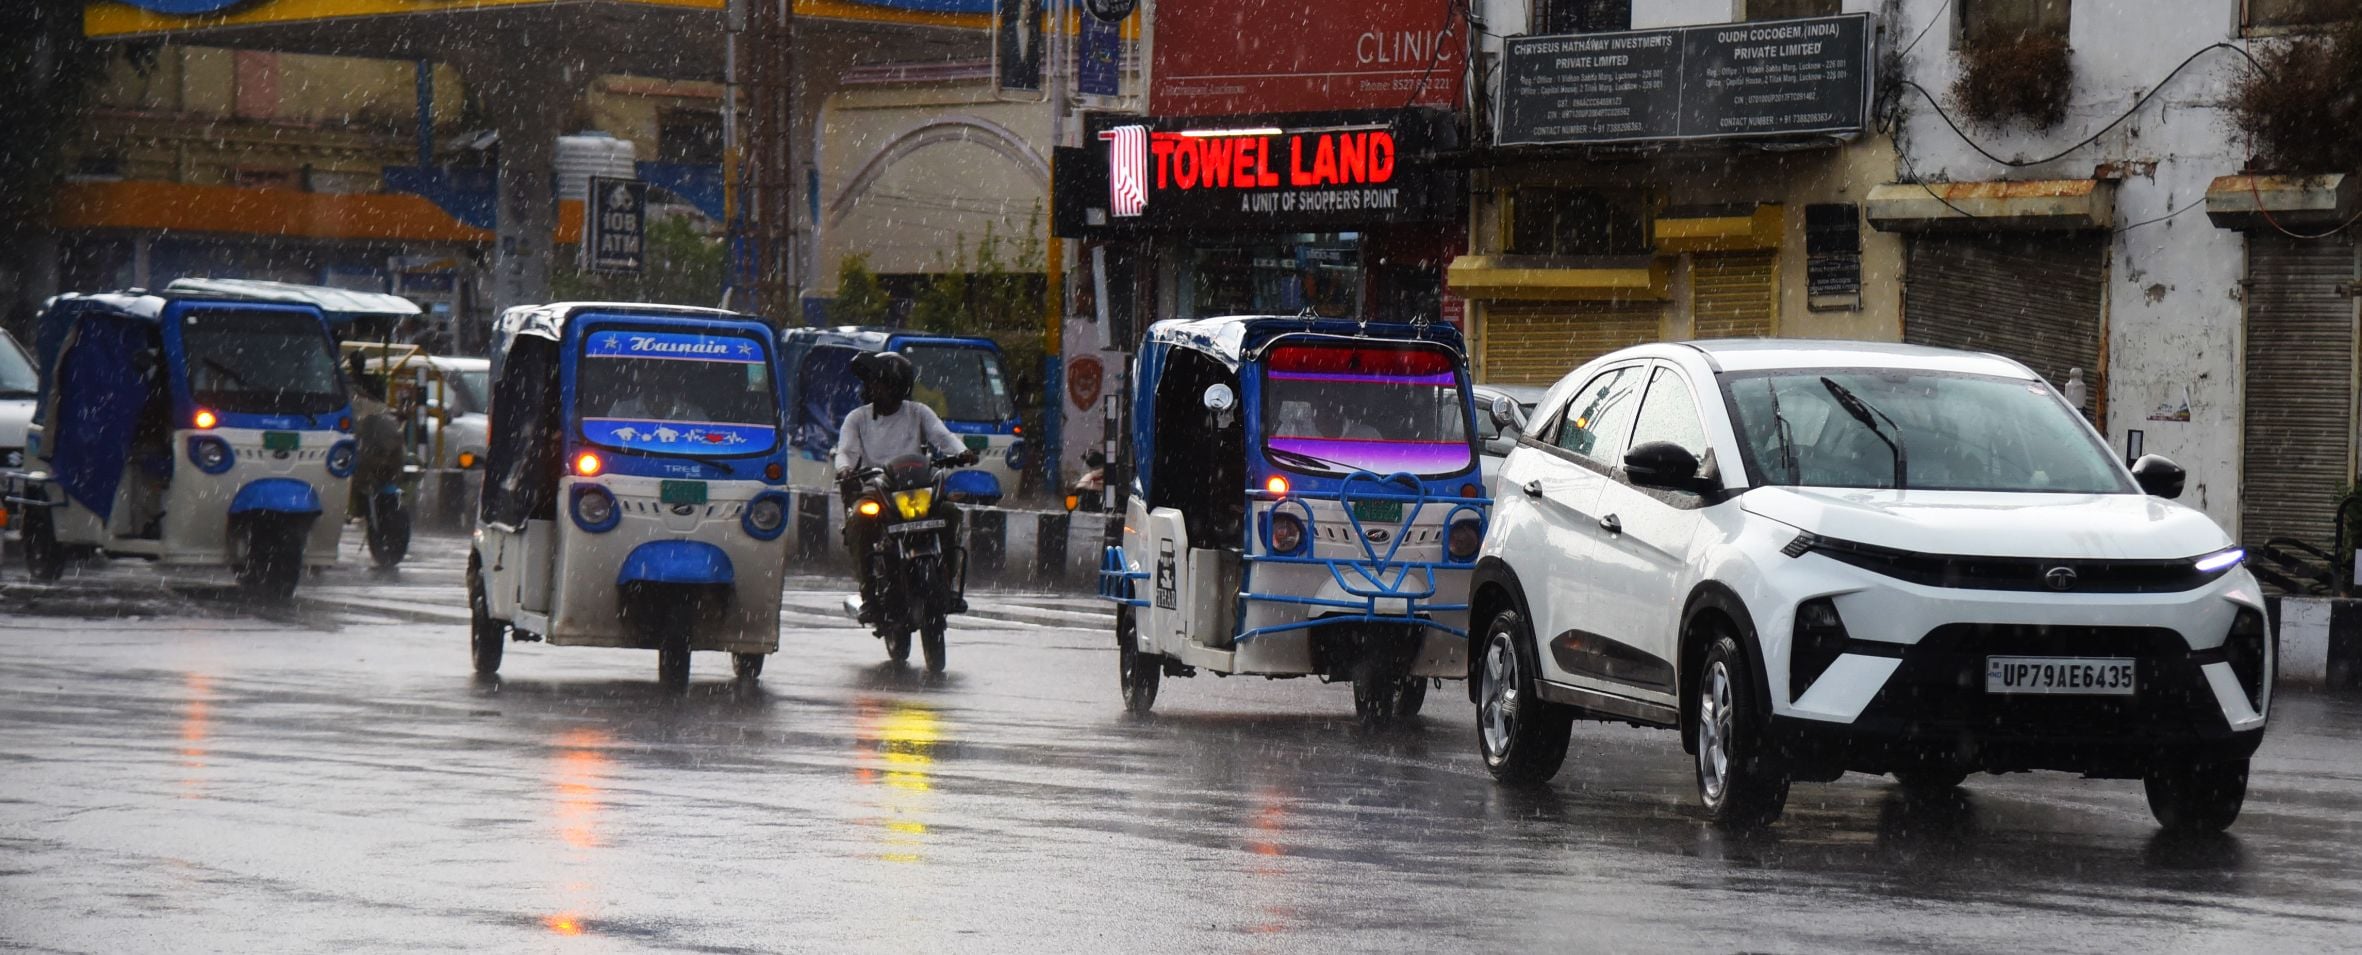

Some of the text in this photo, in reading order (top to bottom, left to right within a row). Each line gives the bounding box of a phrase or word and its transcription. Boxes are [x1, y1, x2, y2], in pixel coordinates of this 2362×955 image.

[1718, 23, 1840, 44] OUDH COCOGEM (INDIA)
[1356, 29, 1453, 64] CLINIC
[1514, 35, 1673, 56] CHRYSEUS HATHAWAY INVESTMENTS
[1734, 43, 1821, 60] PRIVATE LIMITED
[1555, 55, 1629, 69] PRIVATE LIMITED
[1799, 62, 1821, 71] Lucknow
[1392, 78, 1415, 91] 8527
[1434, 77, 1450, 90] 221
[1799, 73, 1821, 82] Lucknow
[1720, 116, 1747, 127] CONTACT
[1748, 115, 1774, 126] NUMBER
[1784, 114, 1791, 124] 91
[1533, 126, 1561, 136] CONTACT
[1561, 124, 1587, 135] NUMBER
[1598, 124, 1605, 133] 91
[1151, 131, 1396, 190] TOWEL LAND
[1241, 188, 1399, 212] A UNIT OF SHOPPER'S POINT
[602, 234, 640, 253] ATM
[628, 336, 730, 354] Hasnain
[1157, 588, 1175, 608] THAR
[2003, 663, 2133, 688] UP79AE6435
